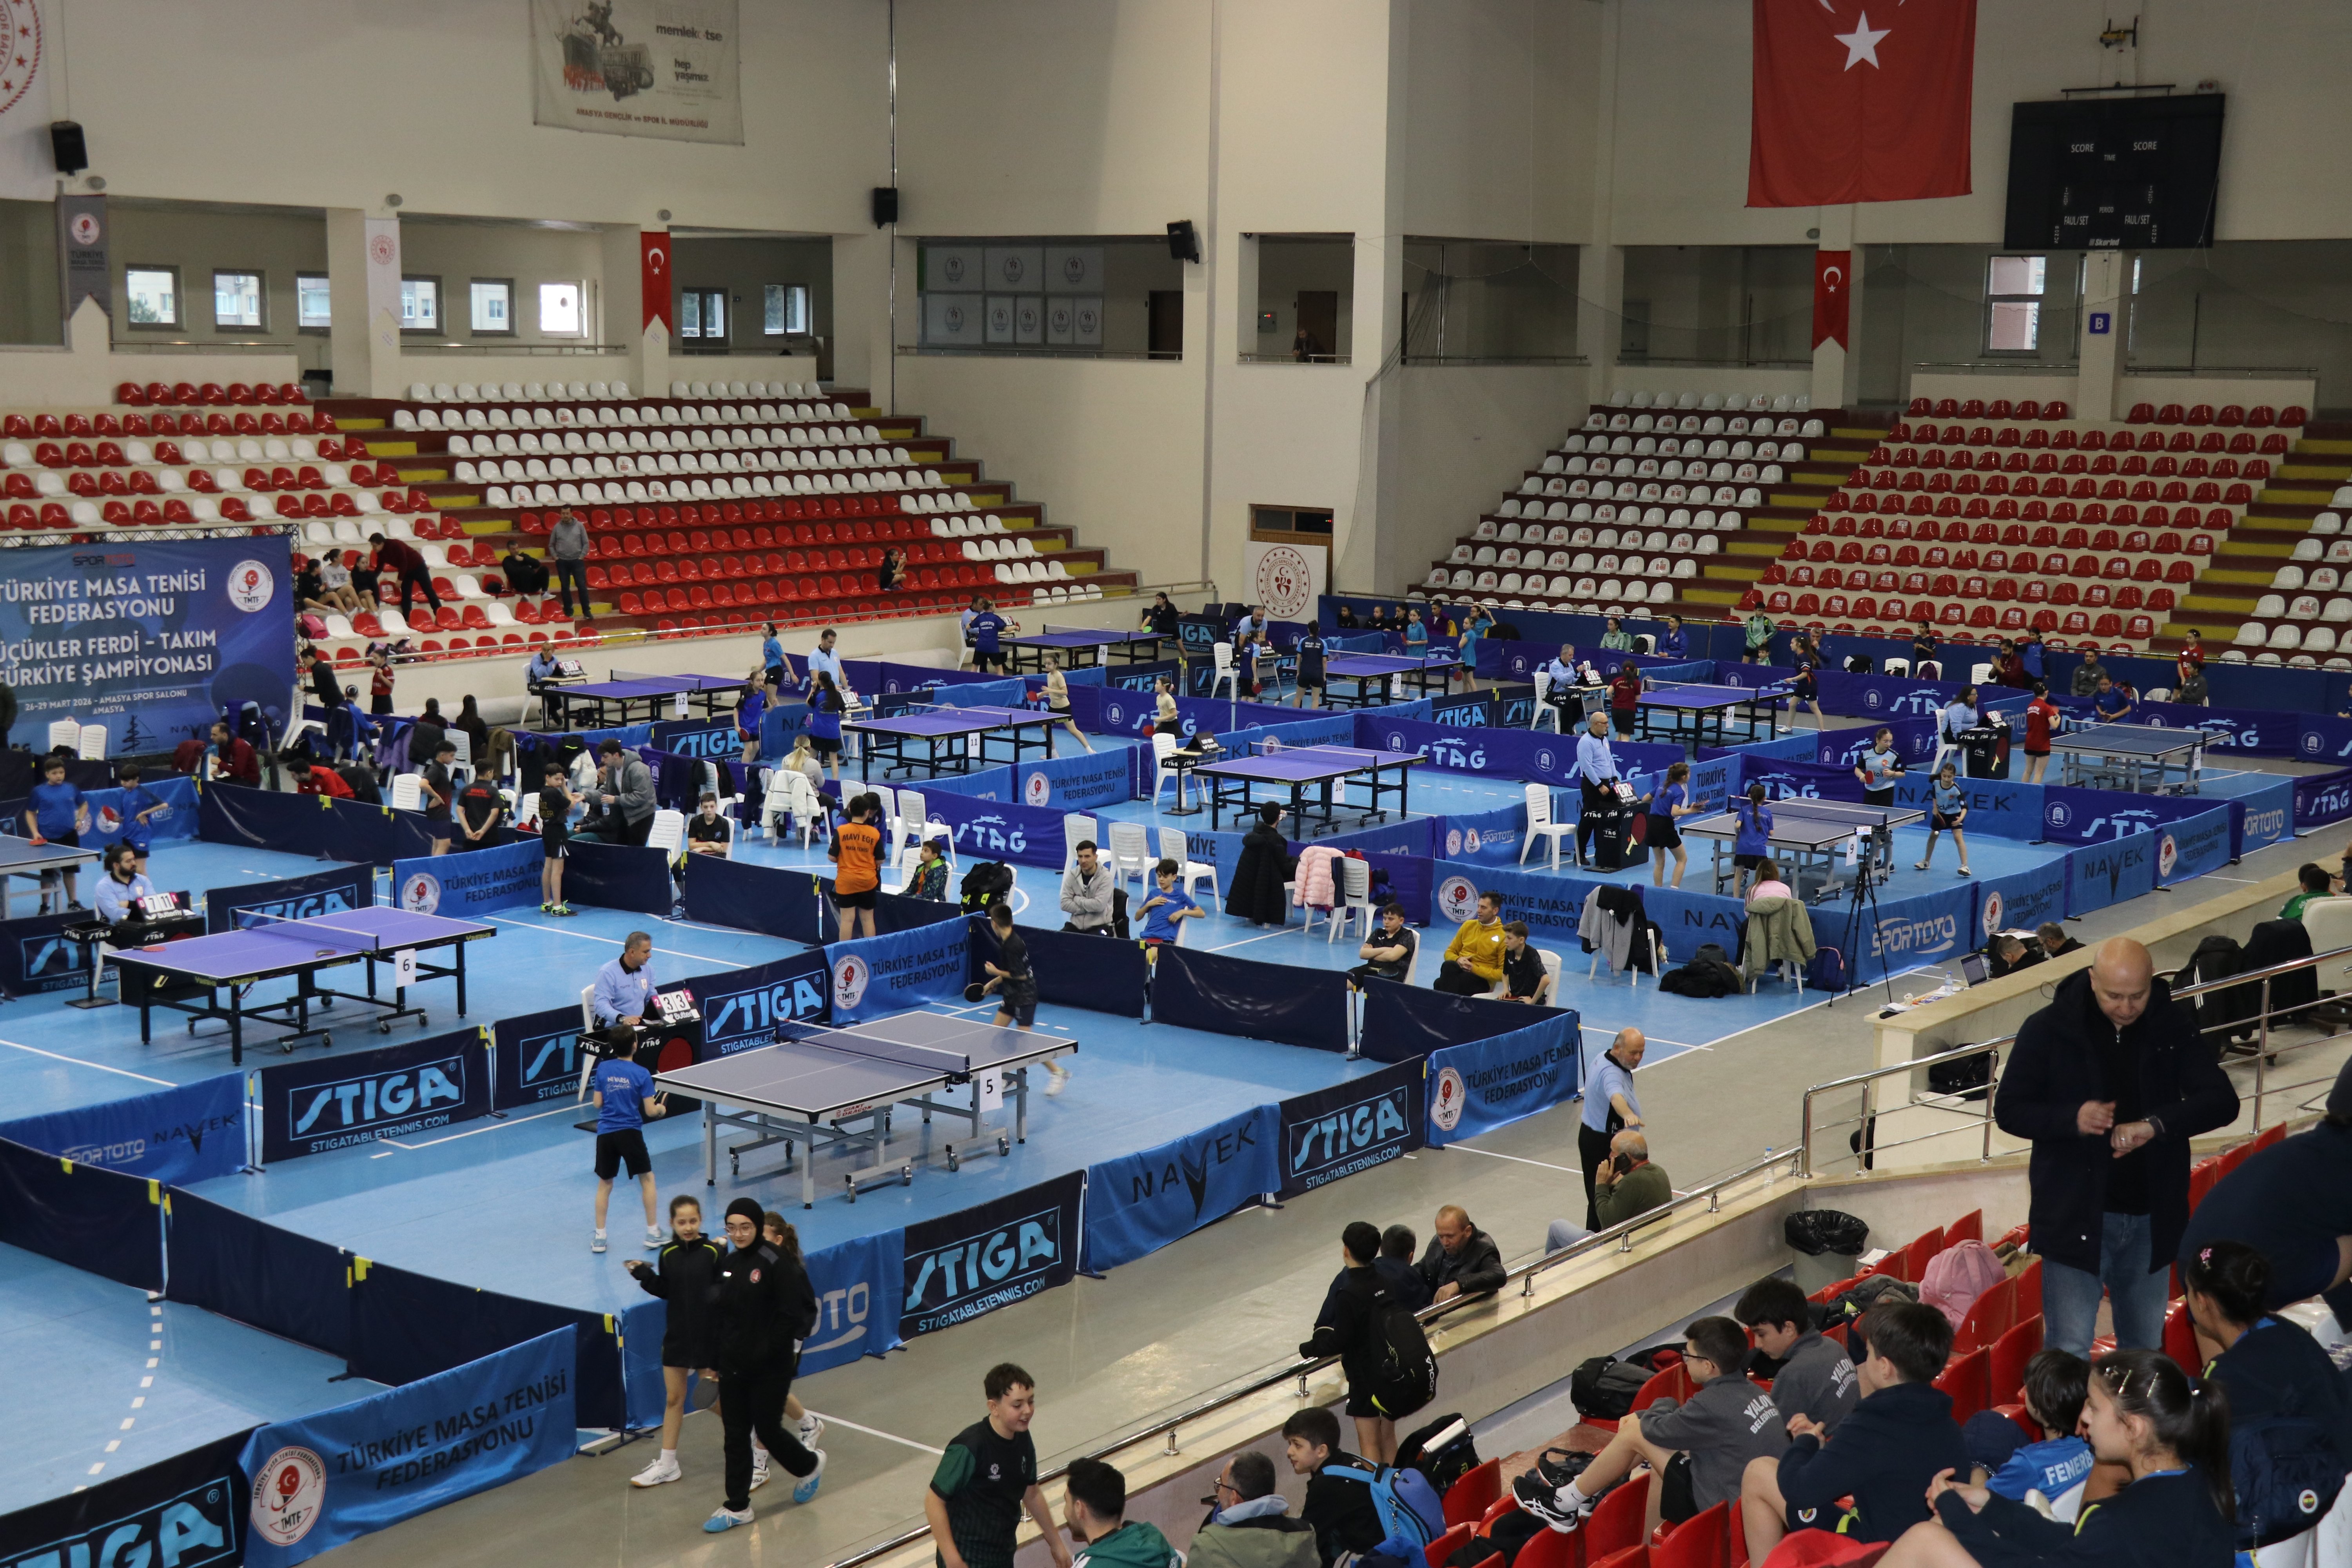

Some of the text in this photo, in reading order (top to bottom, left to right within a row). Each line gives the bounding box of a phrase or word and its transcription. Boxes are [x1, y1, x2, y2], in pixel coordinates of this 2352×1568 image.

[675, 58, 691, 71] hep
[576, 108, 603, 118] AMASYA
[604, 111, 632, 122] GENÇLİK
[670, 118, 708, 129] MÜDÜRLÜĞÜ
[2071, 142, 2157, 152] SCORE SCORE
[2064, 215, 2150, 225] FAUL/SET FAUL/SET
[2095, 318, 2103, 329] B
[86, 576, 142, 597] MASA
[147, 568, 206, 593] TENİSİ
[30, 598, 174, 624] FEDERASYONU
[88, 630, 139, 655] FERDİ
[160, 630, 216, 650] TAKIM
[82, 653, 212, 686] ŞAMPİYONASI
[565, 662, 575, 671] 6 7
[25, 689, 187, 711] 26-29 MART 2026 AMASYA SPOR SALONU
[93, 705, 125, 715] AMASYA
[1436, 706, 1485, 728] STIGA
[673, 730, 744, 755] STIGA
[1312, 736, 1330, 745] MASA
[1332, 730, 1351, 742] TENİSİ
[1417, 745, 1486, 769] STAG
[1796, 750, 1814, 762] TENİSİ
[1051, 767, 1126, 789] TÜRKİYE MASA TENİSİ
[1336, 783, 1343, 791] 10
[1697, 768, 1726, 788] TÜRKİYE
[1064, 783, 1115, 800] FEDERASYONU
[1619, 786, 1630, 795] 8 2
[1711, 787, 1726, 799] TENİSİ
[1898, 787, 2011, 811] NAEK
[2309, 790, 2348, 817] STAG
[862, 835, 874, 845] EGE
[954, 823, 1027, 853] STAG
[1482, 830, 1514, 844] SPORTOTO
[1850, 844, 1854, 854] 9
[445, 861, 544, 891] TÜRKİYE MASA TEN
[2085, 846, 2143, 899] NAVEK
[140, 899, 145, 907] 0
[149, 896, 156, 910] 7
[161, 895, 171, 909] 11
[242, 893, 354, 927] STIGA
[1539, 896, 1574, 913] MASA
[2005, 894, 2029, 911] TÜRKİYE
[157, 910, 182, 919] Butterfly
[1506, 909, 1581, 929] FEDERASYO
[64, 931, 80, 940] STAG
[88, 929, 112, 940] STAG
[145, 932, 165, 941] STAG
[1871, 915, 1956, 956] SPORTOTO
[403, 959, 410, 971] 6
[872, 946, 944, 975] TÜRKİYE MASA
[891, 961, 960, 989] FEDERASYONU
[654, 992, 693, 1011] 2 3 3 2
[842, 992, 855, 1000] TMTF
[674, 1010, 692, 1020] Butter
[710, 979, 822, 1037] STIGA
[580, 1042, 600, 1053] STAG
[641, 1039, 660, 1048] STAG
[1466, 1064, 1509, 1090] TÜRKİYE
[1511, 1054, 1541, 1077] MASA
[987, 1079, 993, 1094] 5
[1484, 1069, 1558, 1105] FEDERASYONU
[296, 1067, 459, 1134] STIGA
[842, 1105, 872, 1116] DRAGON
[844, 1103, 864, 1112] GIANT
[155, 1113, 237, 1155] NAVEK
[311, 1114, 449, 1153] STIGATABLETENNIS.COM
[1294, 1098, 1404, 1170] STIGA
[1133, 1121, 1255, 1223] NAVEK
[1306, 1145, 1401, 1189] STIGATABLETENNIS.COM
[906, 1221, 1054, 1311] STIGA
[918, 1276, 1045, 1332] STIGATABLETENNIS.COM
[1425, 1355, 1435, 1392] JOOLA
[1744, 1394, 1776, 1419] YALOV
[338, 1368, 567, 1475] TÜRKİYE MASA TENİSİ
[1750, 1407, 1779, 1434] BELEDİYES
[376, 1416, 534, 1491] FEDERASYONU
[281, 1510, 301, 1530] TMTF
